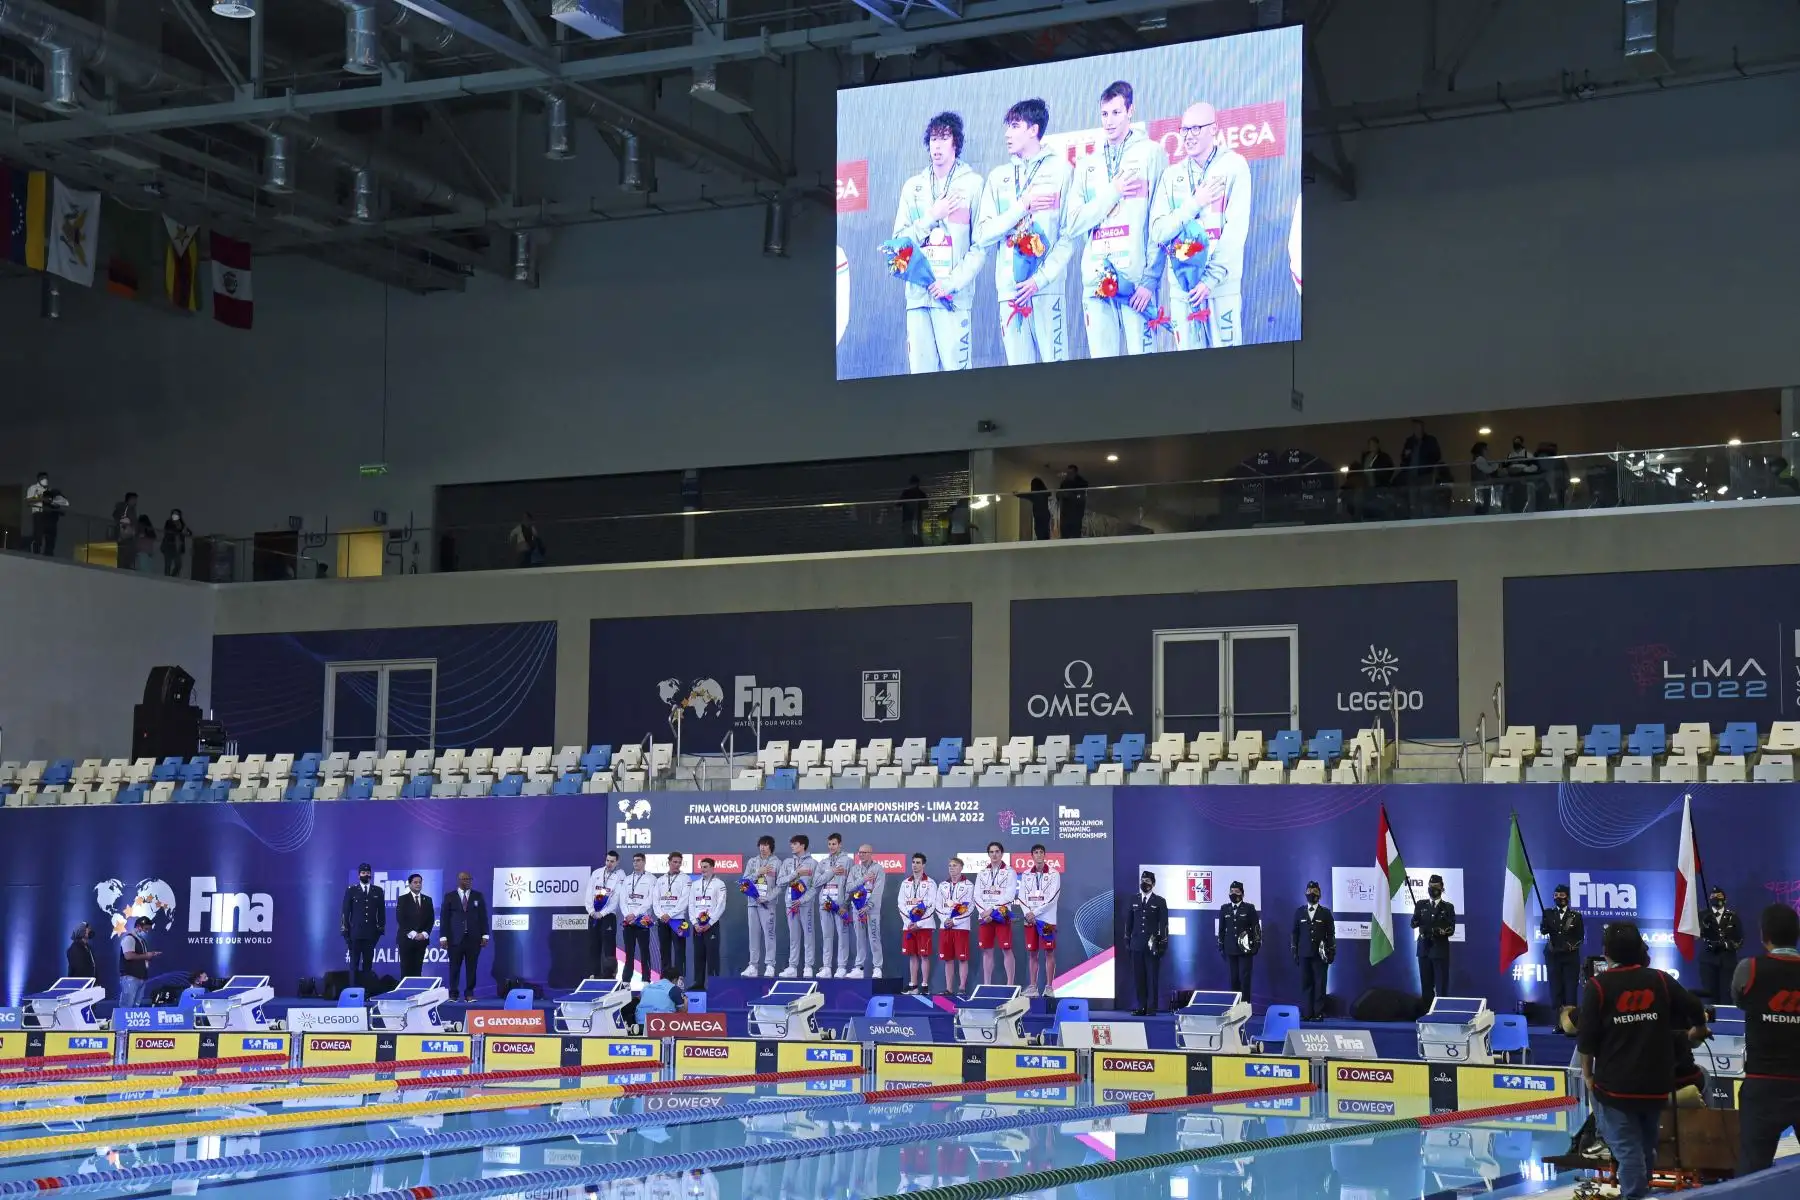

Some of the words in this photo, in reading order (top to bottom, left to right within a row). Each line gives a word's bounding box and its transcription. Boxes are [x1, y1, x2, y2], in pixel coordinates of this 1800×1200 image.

[1216, 121, 1276, 149] MEGA
[1664, 680, 1767, 699] 2022
[734, 675, 802, 717] Fina
[1027, 692, 1133, 718] OMEGA
[689, 804, 710, 813] FINA
[712, 804, 747, 813] WORLD
[749, 803, 783, 813] JUNIOR
[786, 802, 837, 813] SWIMMING
[839, 801, 920, 812] CHAMPIONSHIPS
[927, 801, 951, 811] LIMA
[954, 801, 979, 811] 2022
[684, 816, 705, 825] FINA
[708, 815, 773, 825] CAMPEONATO
[775, 815, 819, 824] MUNDIAL
[821, 814, 857, 824] JUNIOR
[859, 814, 872, 823] DE
[874, 812, 925, 823] NATACIÓN
[932, 813, 957, 823] LIMA
[959, 813, 984, 822] 2022
[616, 822, 651, 844] Fina
[1011, 826, 1049, 834] 2022
[712, 860, 739, 869] MEGA
[1569, 872, 1637, 909] Fina
[188, 876, 274, 932] Fina
[158, 1011, 184, 1024] Fina
[488, 1017, 541, 1027] GATORADE
[1613, 1012, 1658, 1024] MEDIAPRO
[669, 1020, 723, 1031] OMEGA
[775, 1023, 786, 1034] 5
[870, 1025, 884, 1034] SAN
[885, 1026, 915, 1037] CARLOS
[981, 1028, 992, 1039] 6
[1301, 1034, 1328, 1043] LIMA
[88, 1038, 102, 1049] Fina
[145, 1040, 174, 1048] OMEGA
[262, 1039, 277, 1049] Fina
[321, 1040, 350, 1050] OMEGA
[443, 1041, 457, 1052] Fina
[1305, 1042, 1330, 1051] 2022
[1334, 1034, 1364, 1050] Fina
[503, 1043, 534, 1053] OMEGA
[631, 1045, 647, 1056] Fina
[695, 1048, 728, 1057] OMEGA
[1445, 1045, 1458, 1057] 8
[829, 1050, 846, 1061] Fina
[897, 1053, 932, 1063] OMEGA
[1041, 1055, 1060, 1068] Fina
[1116, 1060, 1154, 1070] OMEGA
[1716, 1057, 1730, 1069] 9
[1273, 1065, 1292, 1077] Fina
[1351, 1070, 1392, 1081] OMEGA
[1524, 1077, 1547, 1089] Fina
